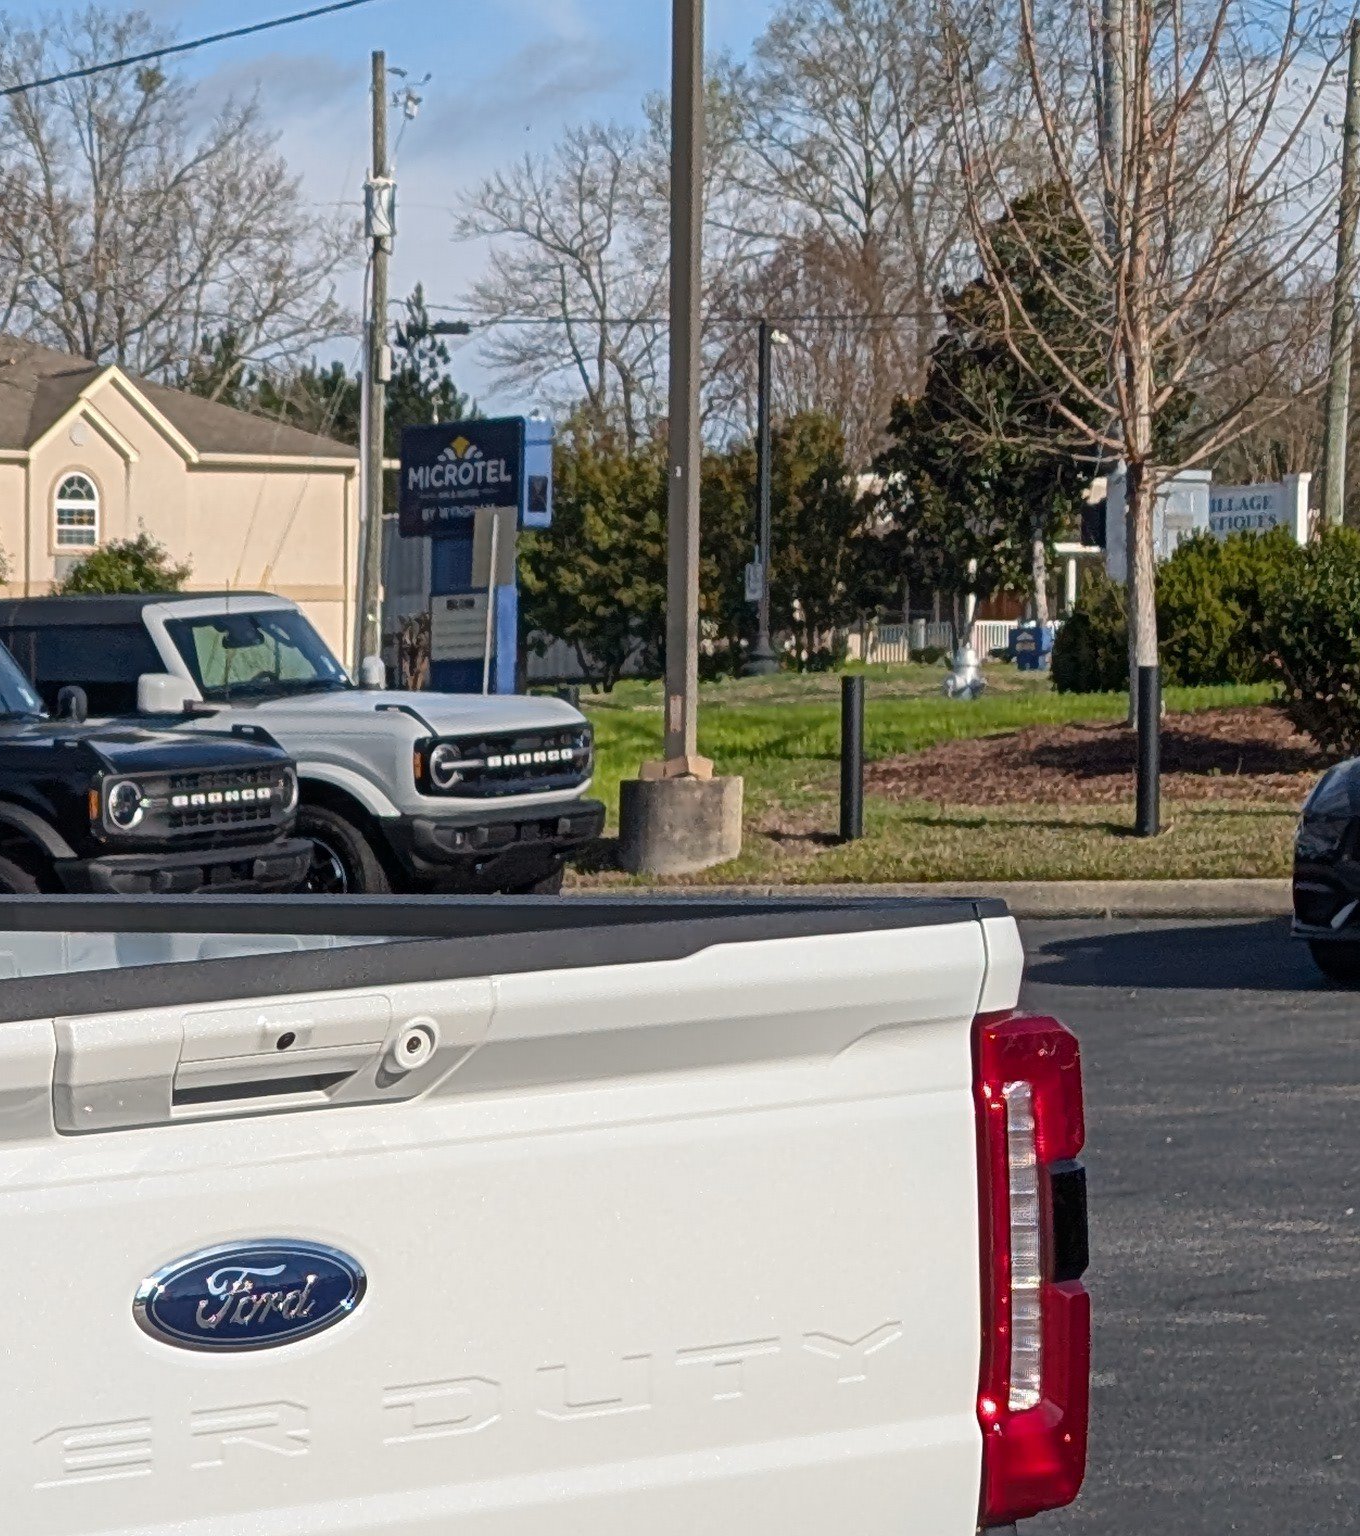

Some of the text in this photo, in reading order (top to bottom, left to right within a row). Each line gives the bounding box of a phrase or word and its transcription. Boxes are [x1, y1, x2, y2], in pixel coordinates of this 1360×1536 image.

[408, 458, 512, 491] MICROTEL
[1211, 495, 1271, 512] ILLAGE
[1211, 513, 1277, 532] TIQUES
[487, 748, 573, 767] BRONCO
[171, 787, 272, 808] BRONCO
[194, 1264, 319, 1330] Ford
[383, 1320, 903, 1445] DUTY
